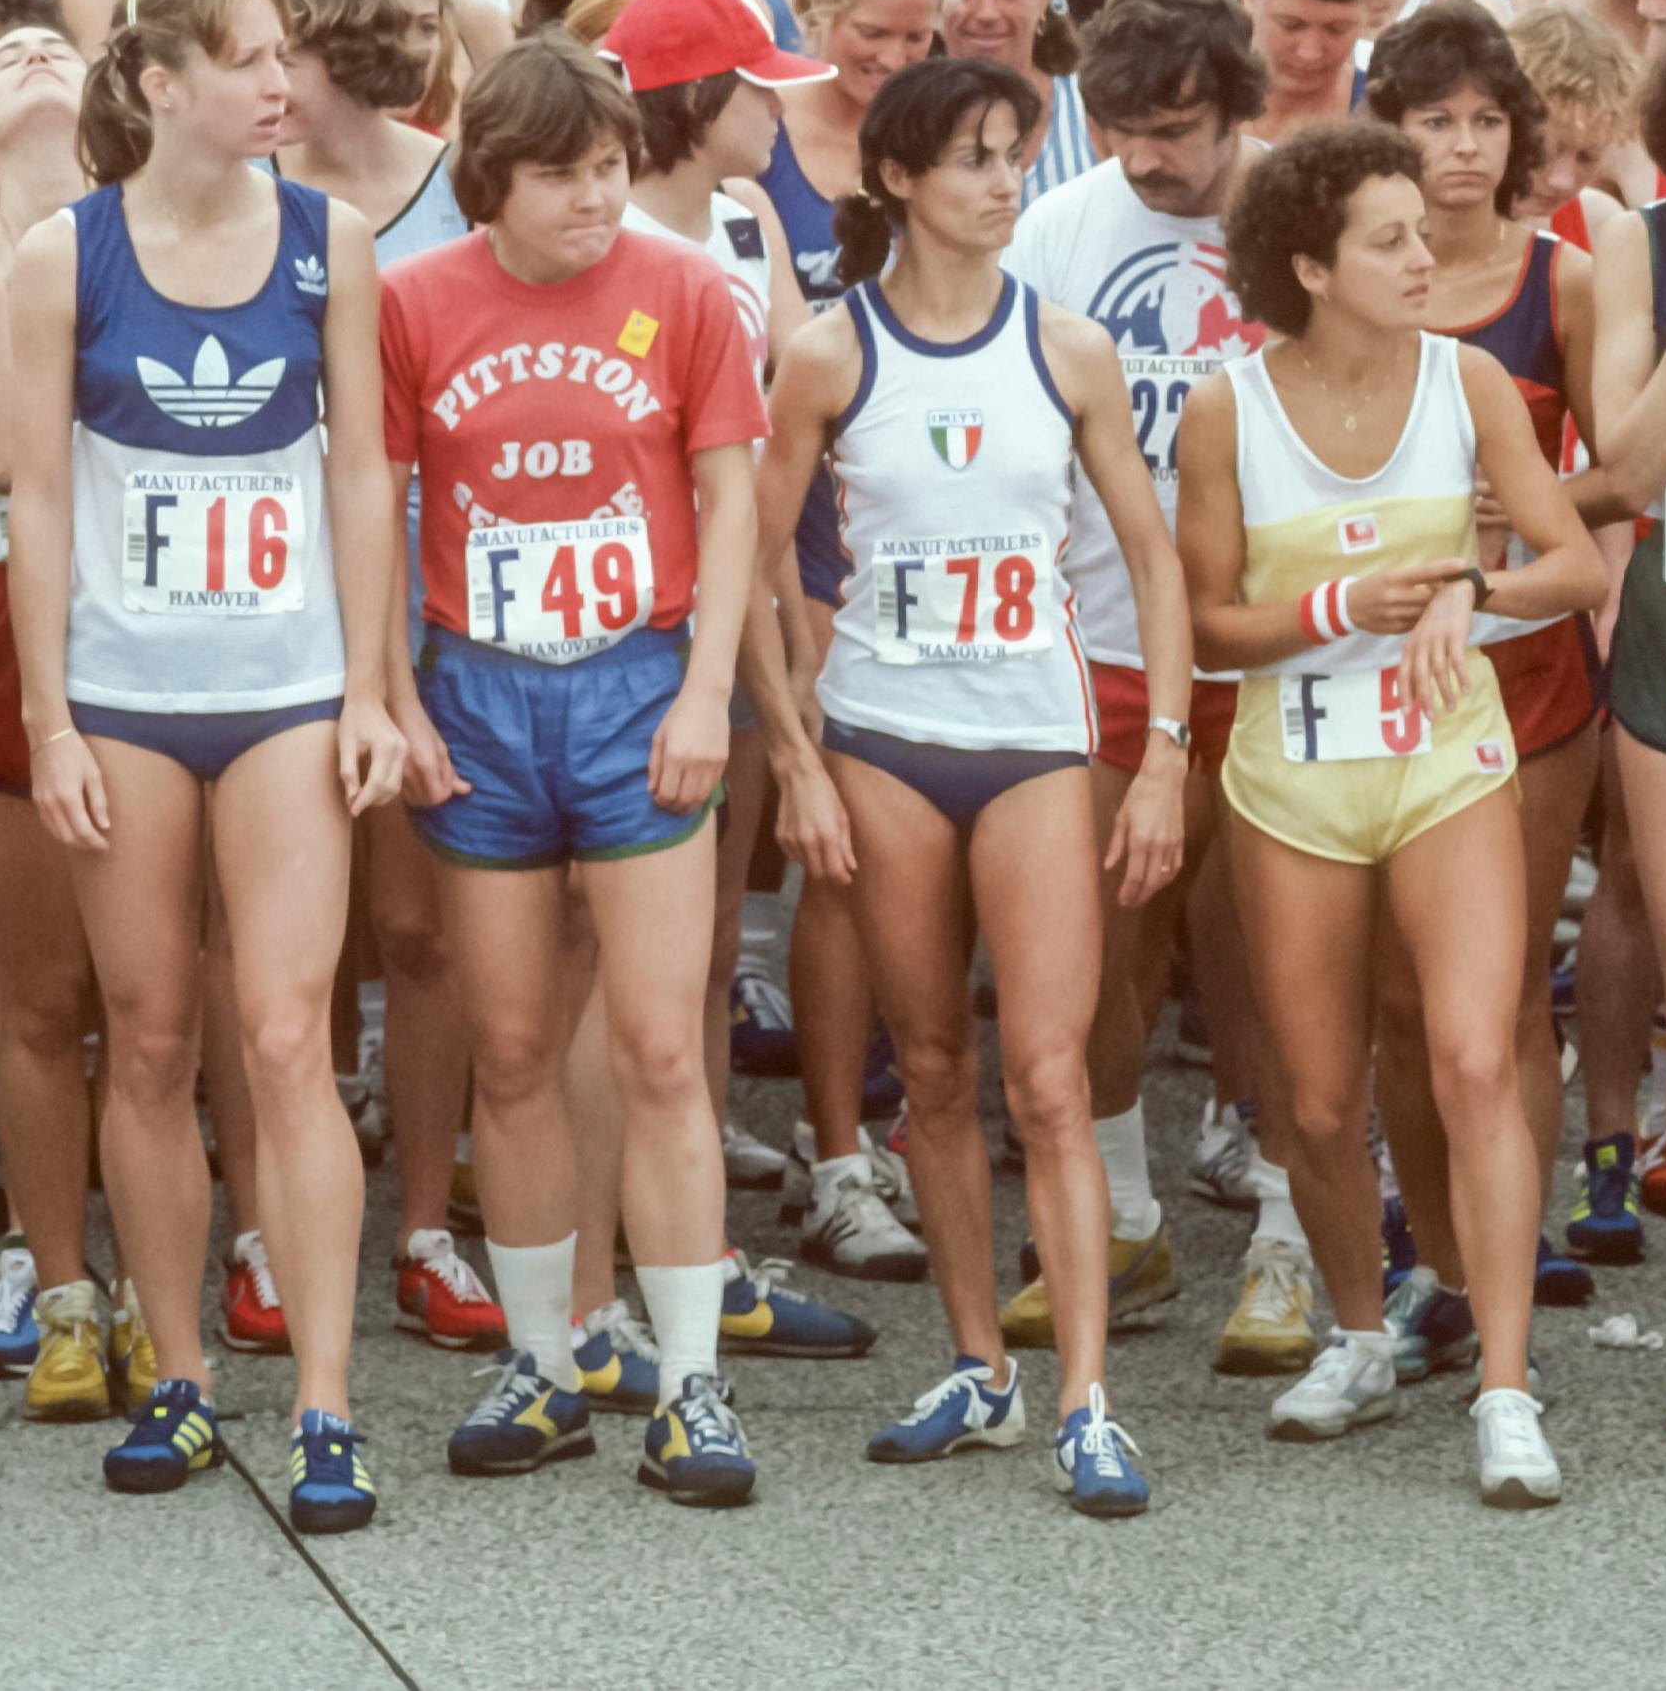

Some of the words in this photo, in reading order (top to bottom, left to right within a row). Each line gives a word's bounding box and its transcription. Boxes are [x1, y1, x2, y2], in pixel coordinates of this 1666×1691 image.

[432, 342, 662, 431] PITTSTON
[491, 439, 594, 480] JOB
[133, 473, 294, 493] MANUFACTURERS
[205, 495, 288, 592] 16
[471, 520, 641, 549] MANUFACTURERS
[882, 532, 1042, 556] MANUFACTURERS
[168, 590, 261, 608] HANOVER
[540, 541, 638, 639] 49
[945, 554, 1036, 644] 78
[518, 635, 610, 657] HANOVER
[917, 643, 1007, 659] HANOVER
